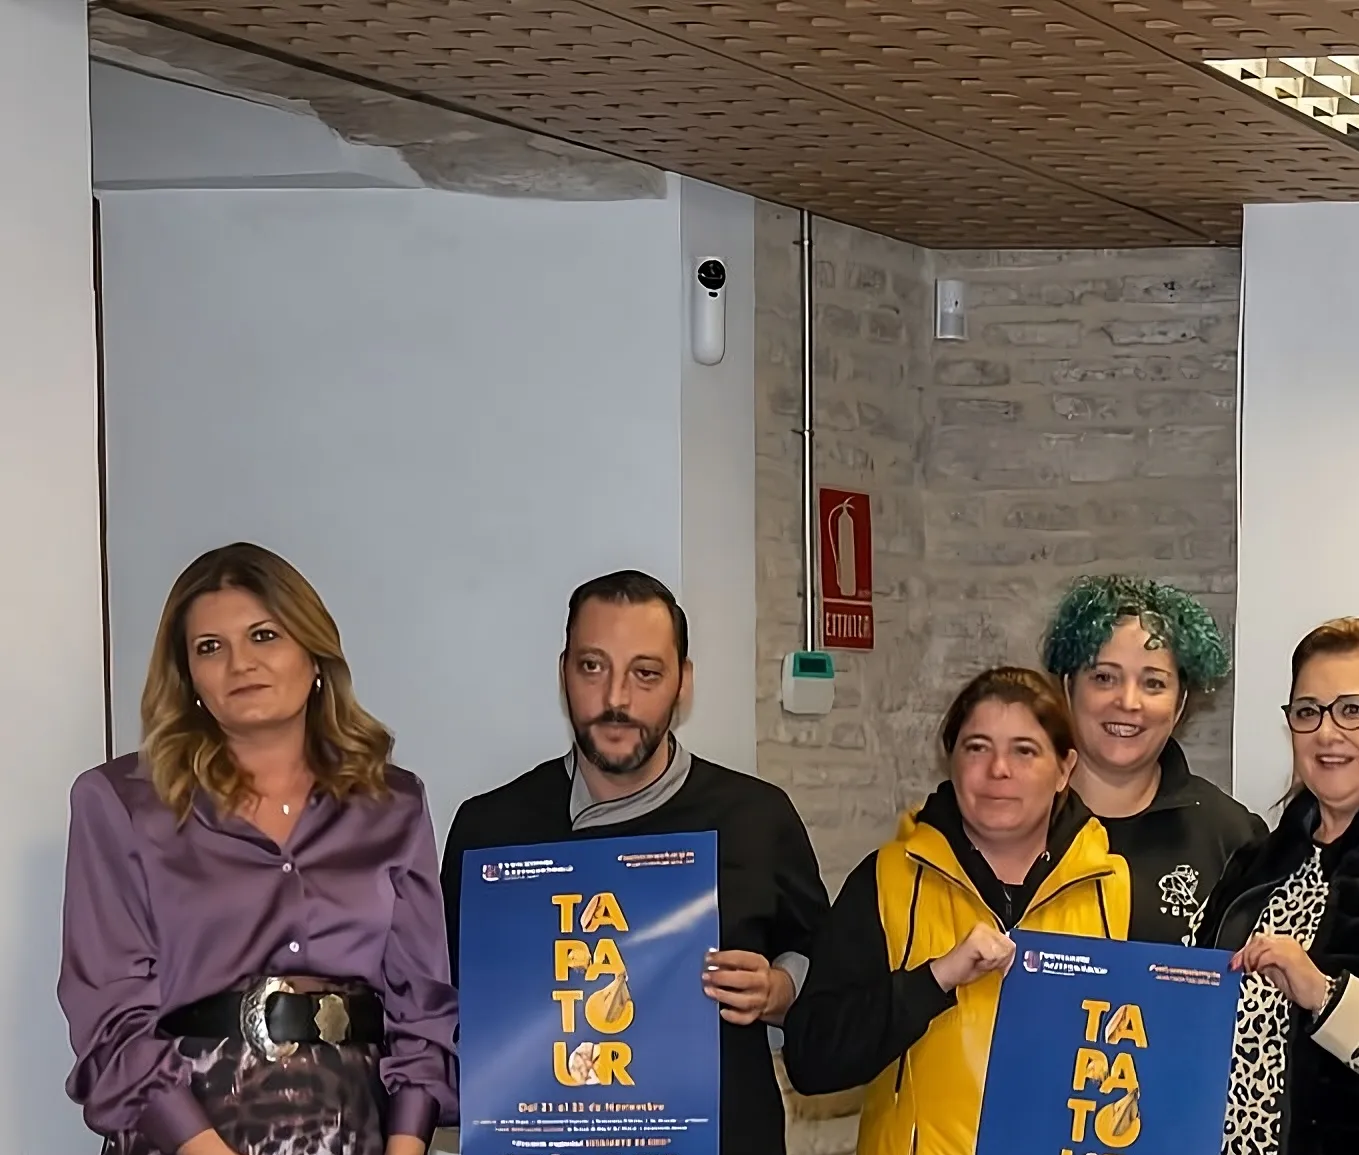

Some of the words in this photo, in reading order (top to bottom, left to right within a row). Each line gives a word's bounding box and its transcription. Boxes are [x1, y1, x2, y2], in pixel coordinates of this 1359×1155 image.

[551, 891, 630, 933] TA
[554, 938, 627, 982] PA
[551, 980, 635, 1034] TO
[1081, 999, 1149, 1049] TA
[1072, 1047, 1140, 1094] PA
[1067, 1091, 1142, 1148] TO
